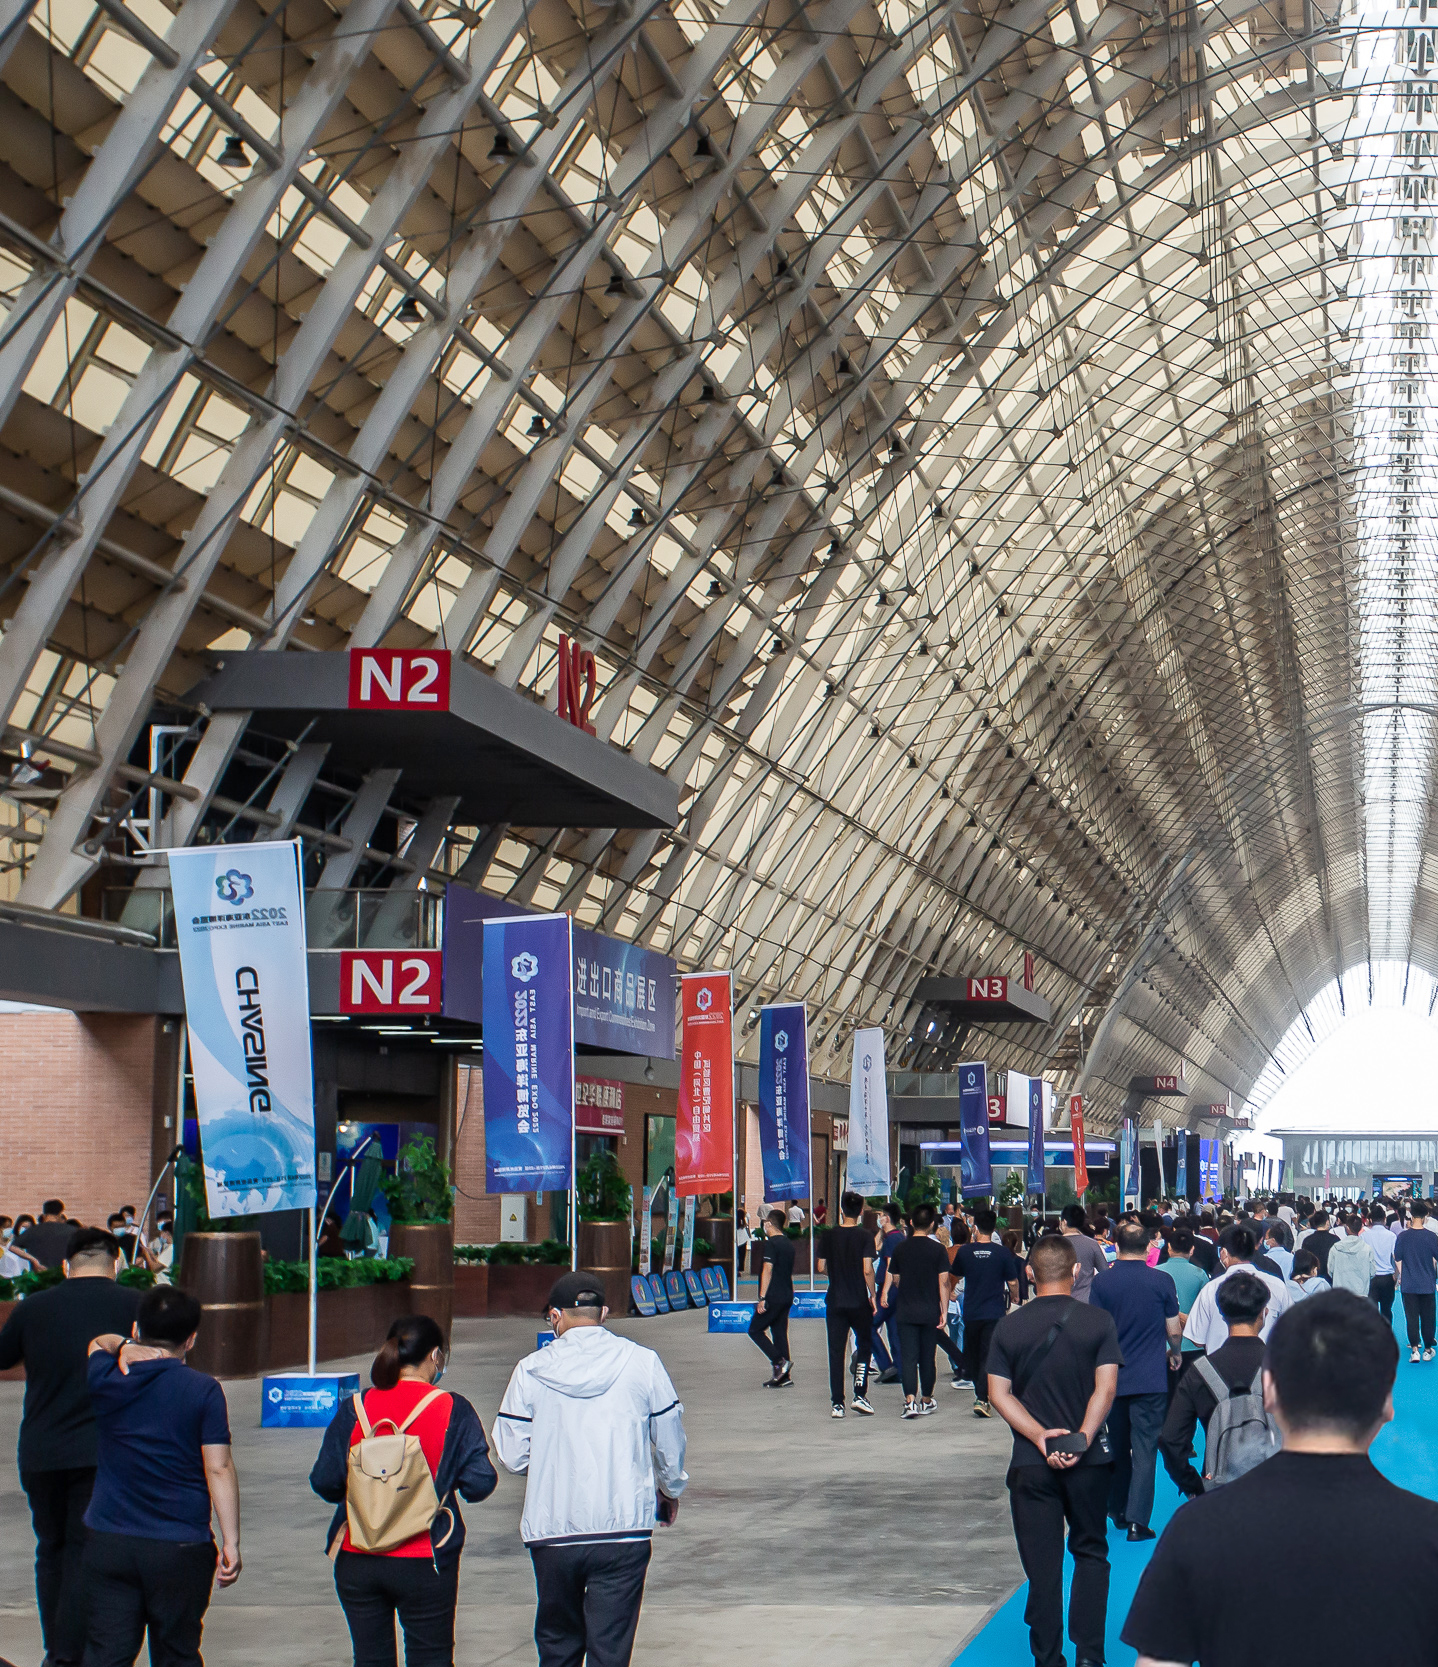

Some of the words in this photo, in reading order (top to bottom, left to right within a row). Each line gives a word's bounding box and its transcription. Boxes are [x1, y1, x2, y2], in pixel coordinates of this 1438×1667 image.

[360, 656, 439, 702] N2
[558, 634, 597, 736] N2
[351, 959, 431, 1005] N2
[577, 957, 657, 1012] 进出口商品展区
[971, 979, 1003, 998] N3
[1156, 1077, 1175, 1088] N4
[989, 1099, 1000, 1118] 3
[1211, 1105, 1225, 1114] N5
